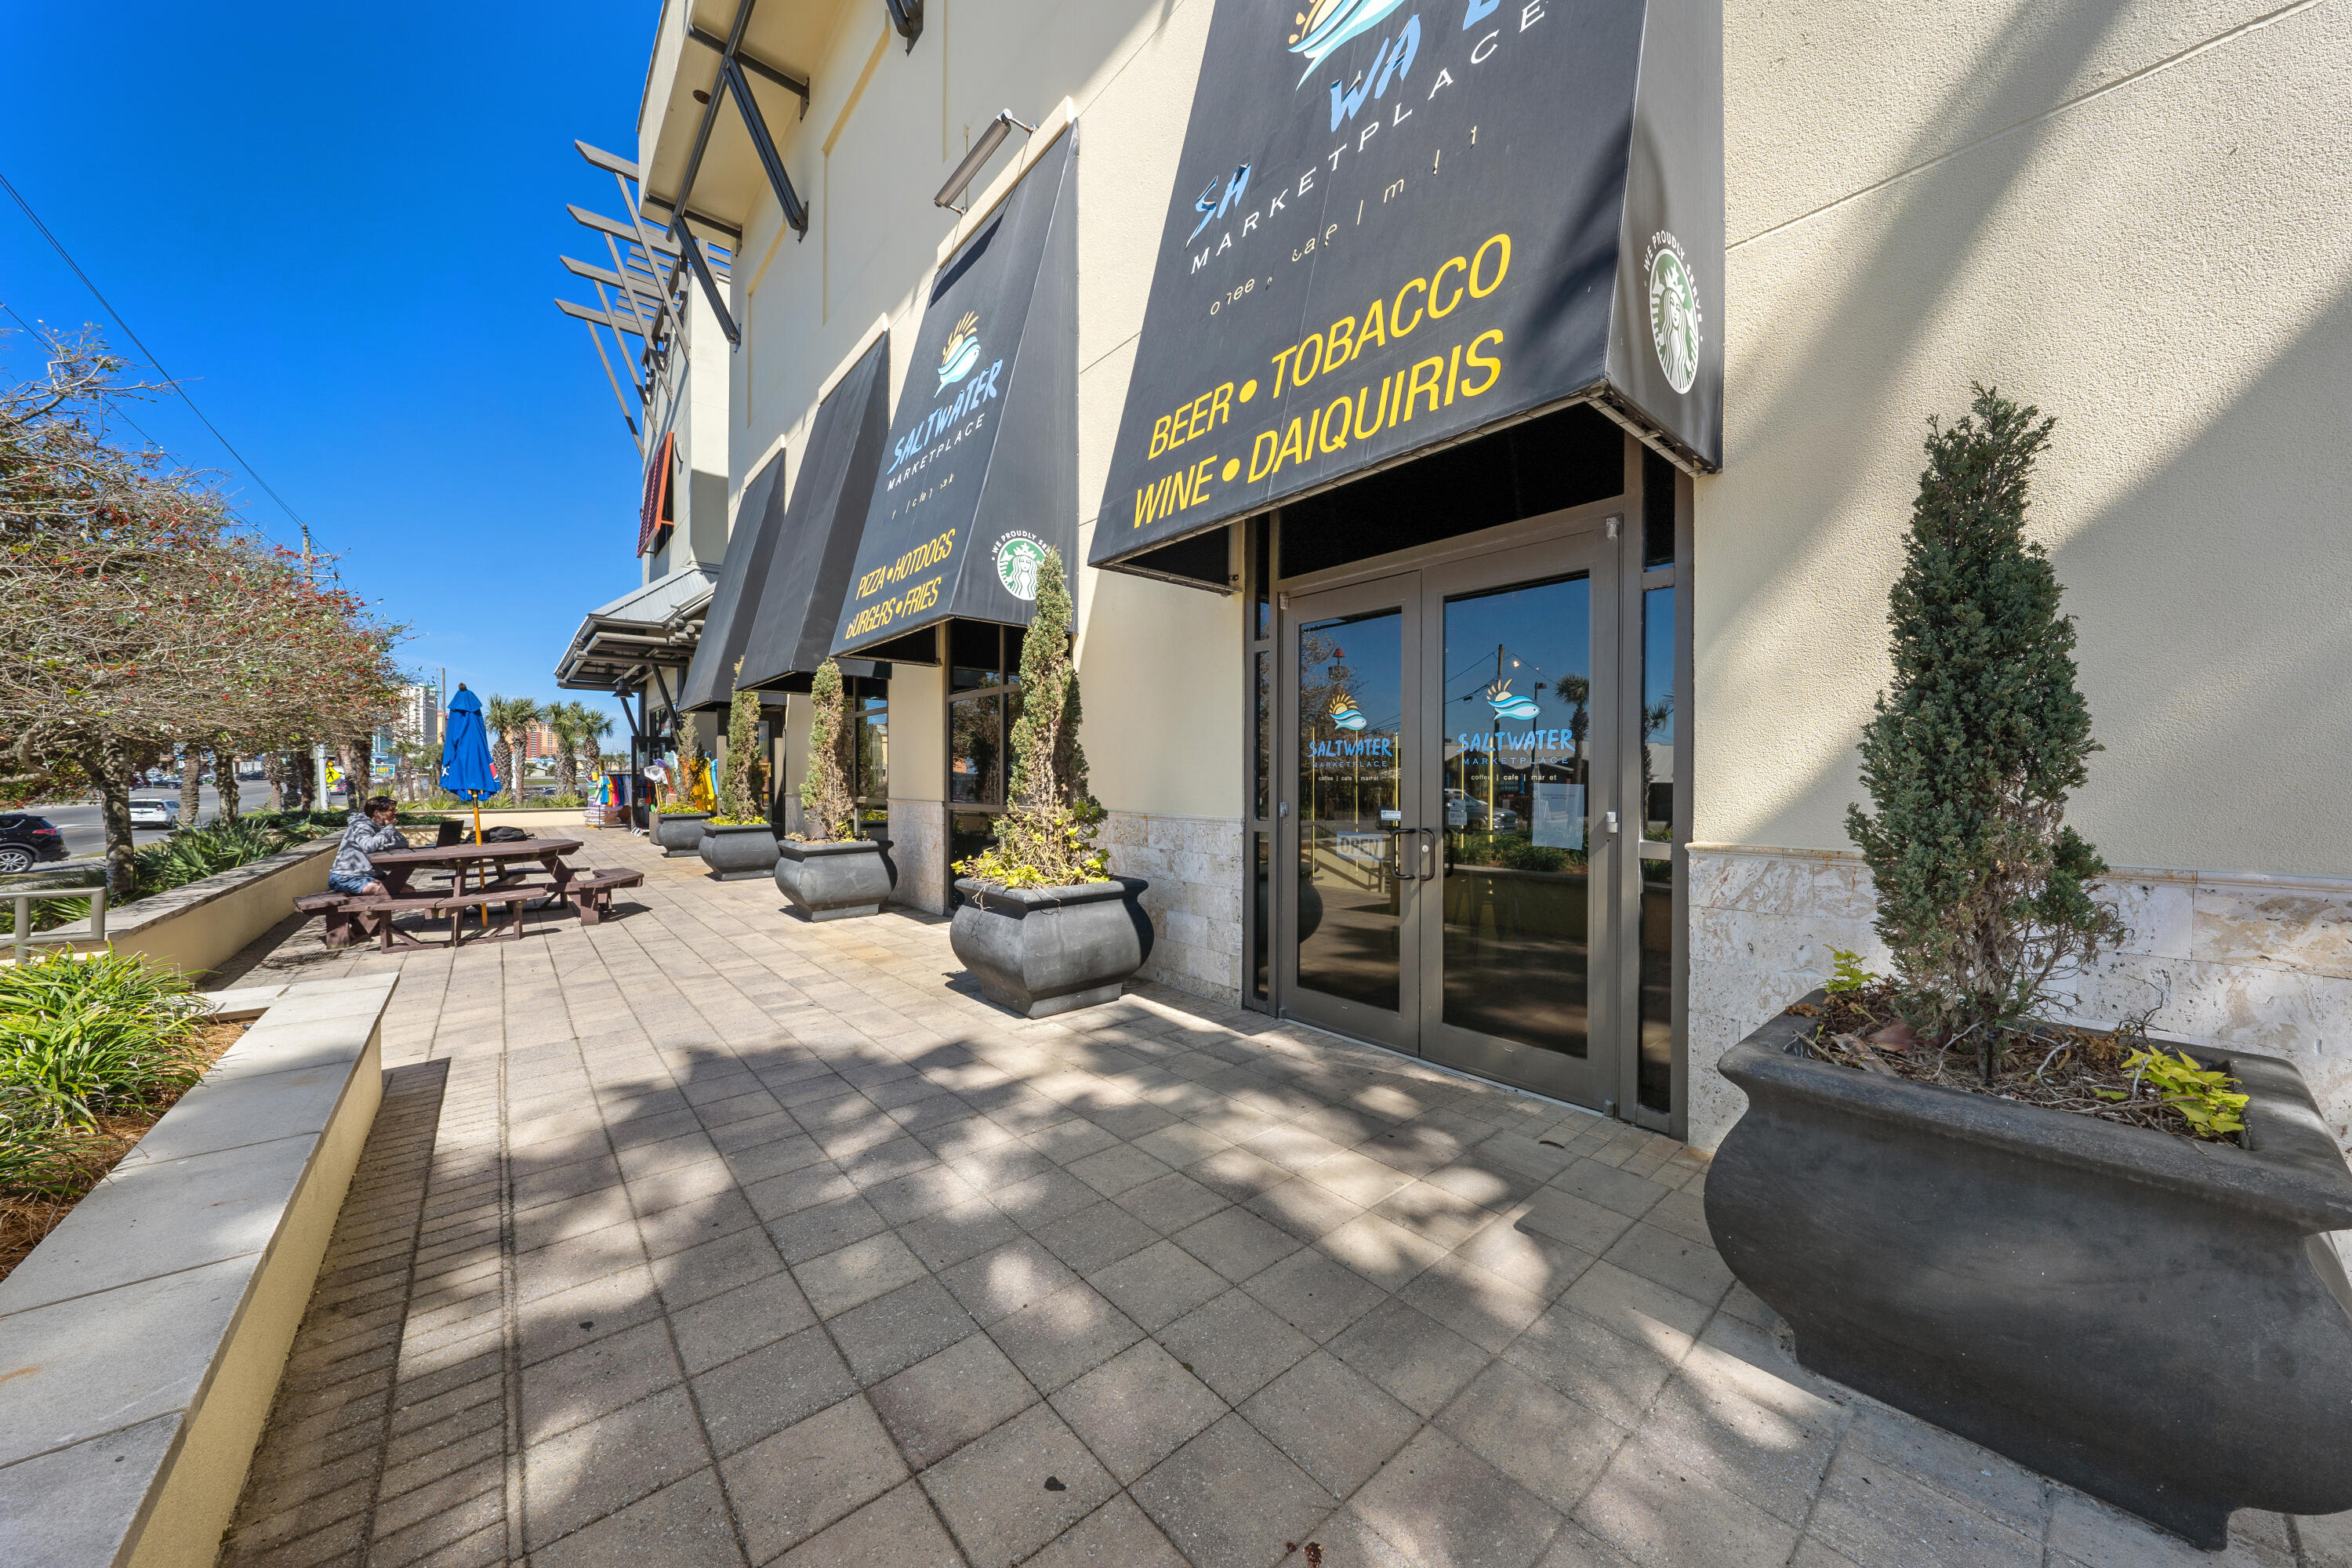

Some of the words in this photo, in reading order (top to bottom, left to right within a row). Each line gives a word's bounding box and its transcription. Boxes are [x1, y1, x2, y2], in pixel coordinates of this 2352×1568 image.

[1190, 0, 1549, 274] MARKETPLACE
[1643, 245, 1653, 272] WE
[1651, 230, 1685, 260] PROUDLY
[1148, 381, 1234, 461] BEER
[1271, 233, 1511, 399] TOBACCO
[887, 359, 1003, 474] SALTWATER
[1134, 456, 1217, 528] WINE
[1247, 328, 1504, 484] DAIQUIRIS
[887, 412, 985, 492] MARKETPLACE
[855, 565, 887, 601] PIZZA
[891, 528, 956, 584] HOTDOGS
[991, 540, 1002, 554] WE
[1000, 530, 1037, 542] PROUDLY
[844, 597, 897, 640] BURGERS
[901, 576, 942, 619] FRIES
[1307, 738, 1392, 757] SALTWATER
[1457, 728, 1576, 753] SALTWATER
[1462, 757, 1569, 765] MARKETPLACE
[1340, 836, 1378, 858] OPEN
